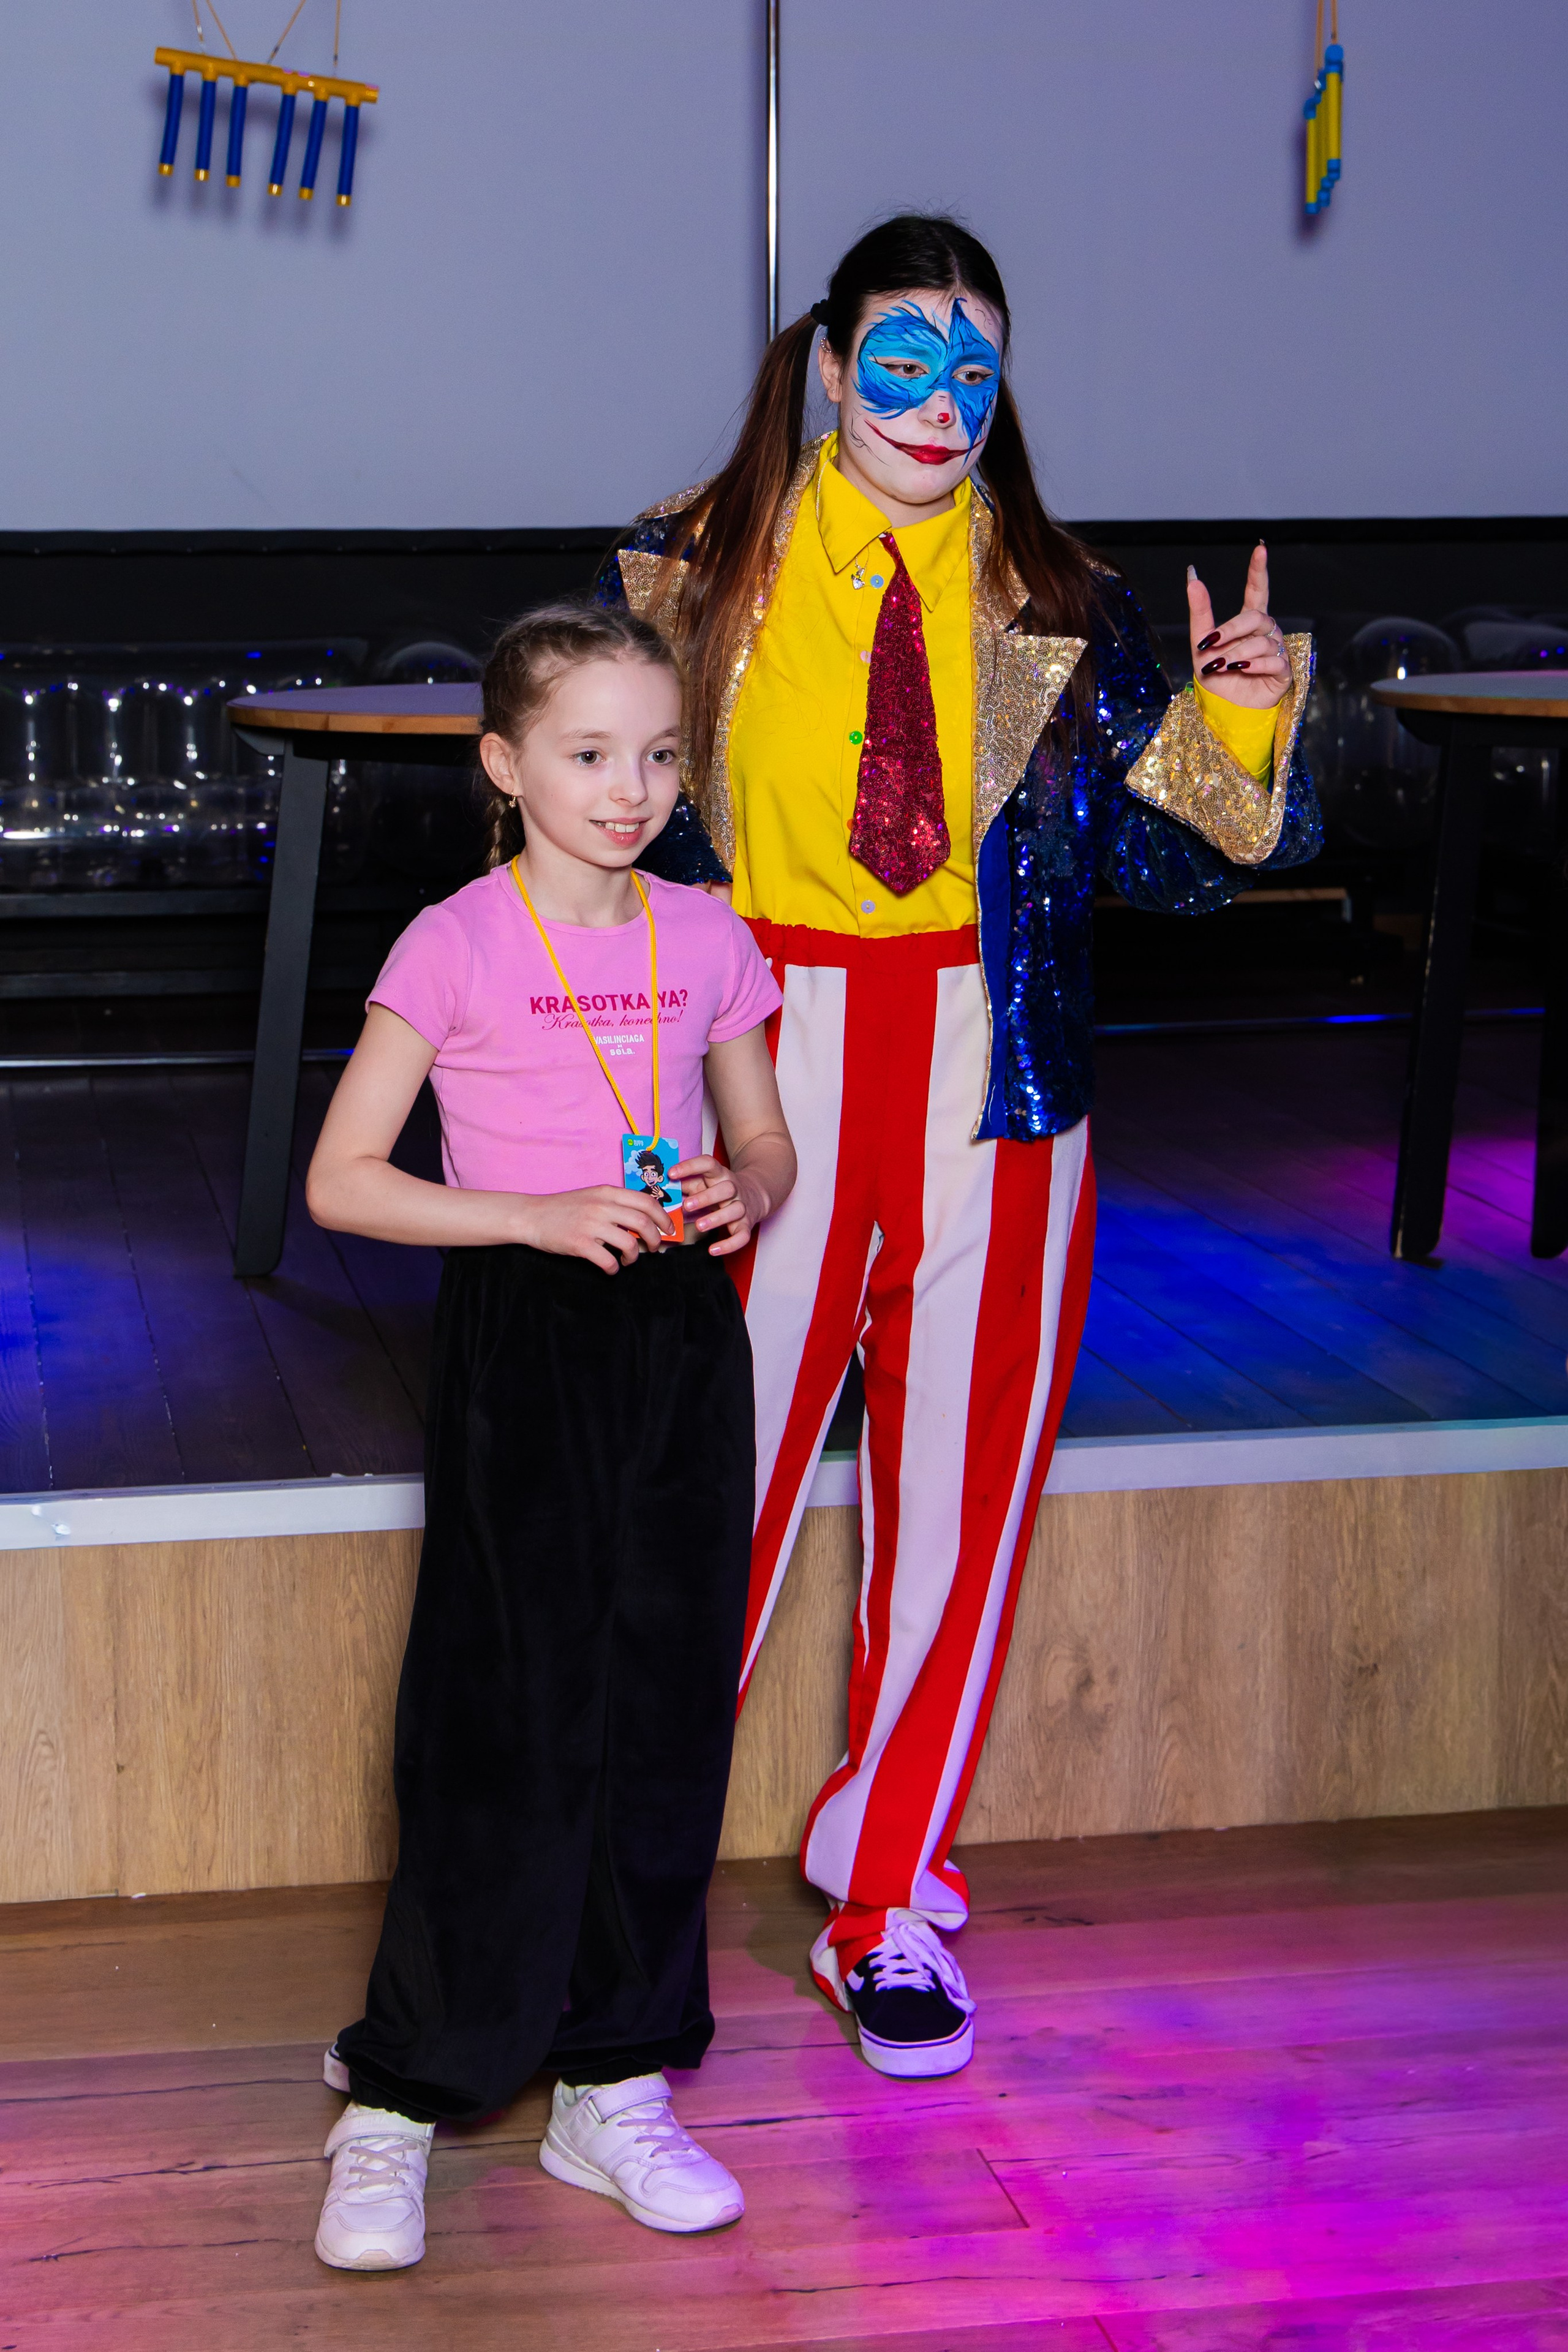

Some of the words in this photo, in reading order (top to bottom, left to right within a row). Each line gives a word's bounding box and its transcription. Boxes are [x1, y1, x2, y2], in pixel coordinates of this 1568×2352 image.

[530, 992, 650, 1014] KRASOTKA
[657, 989, 688, 1008] YA?
[594, 1034, 645, 1045] VASILINCIAGA
